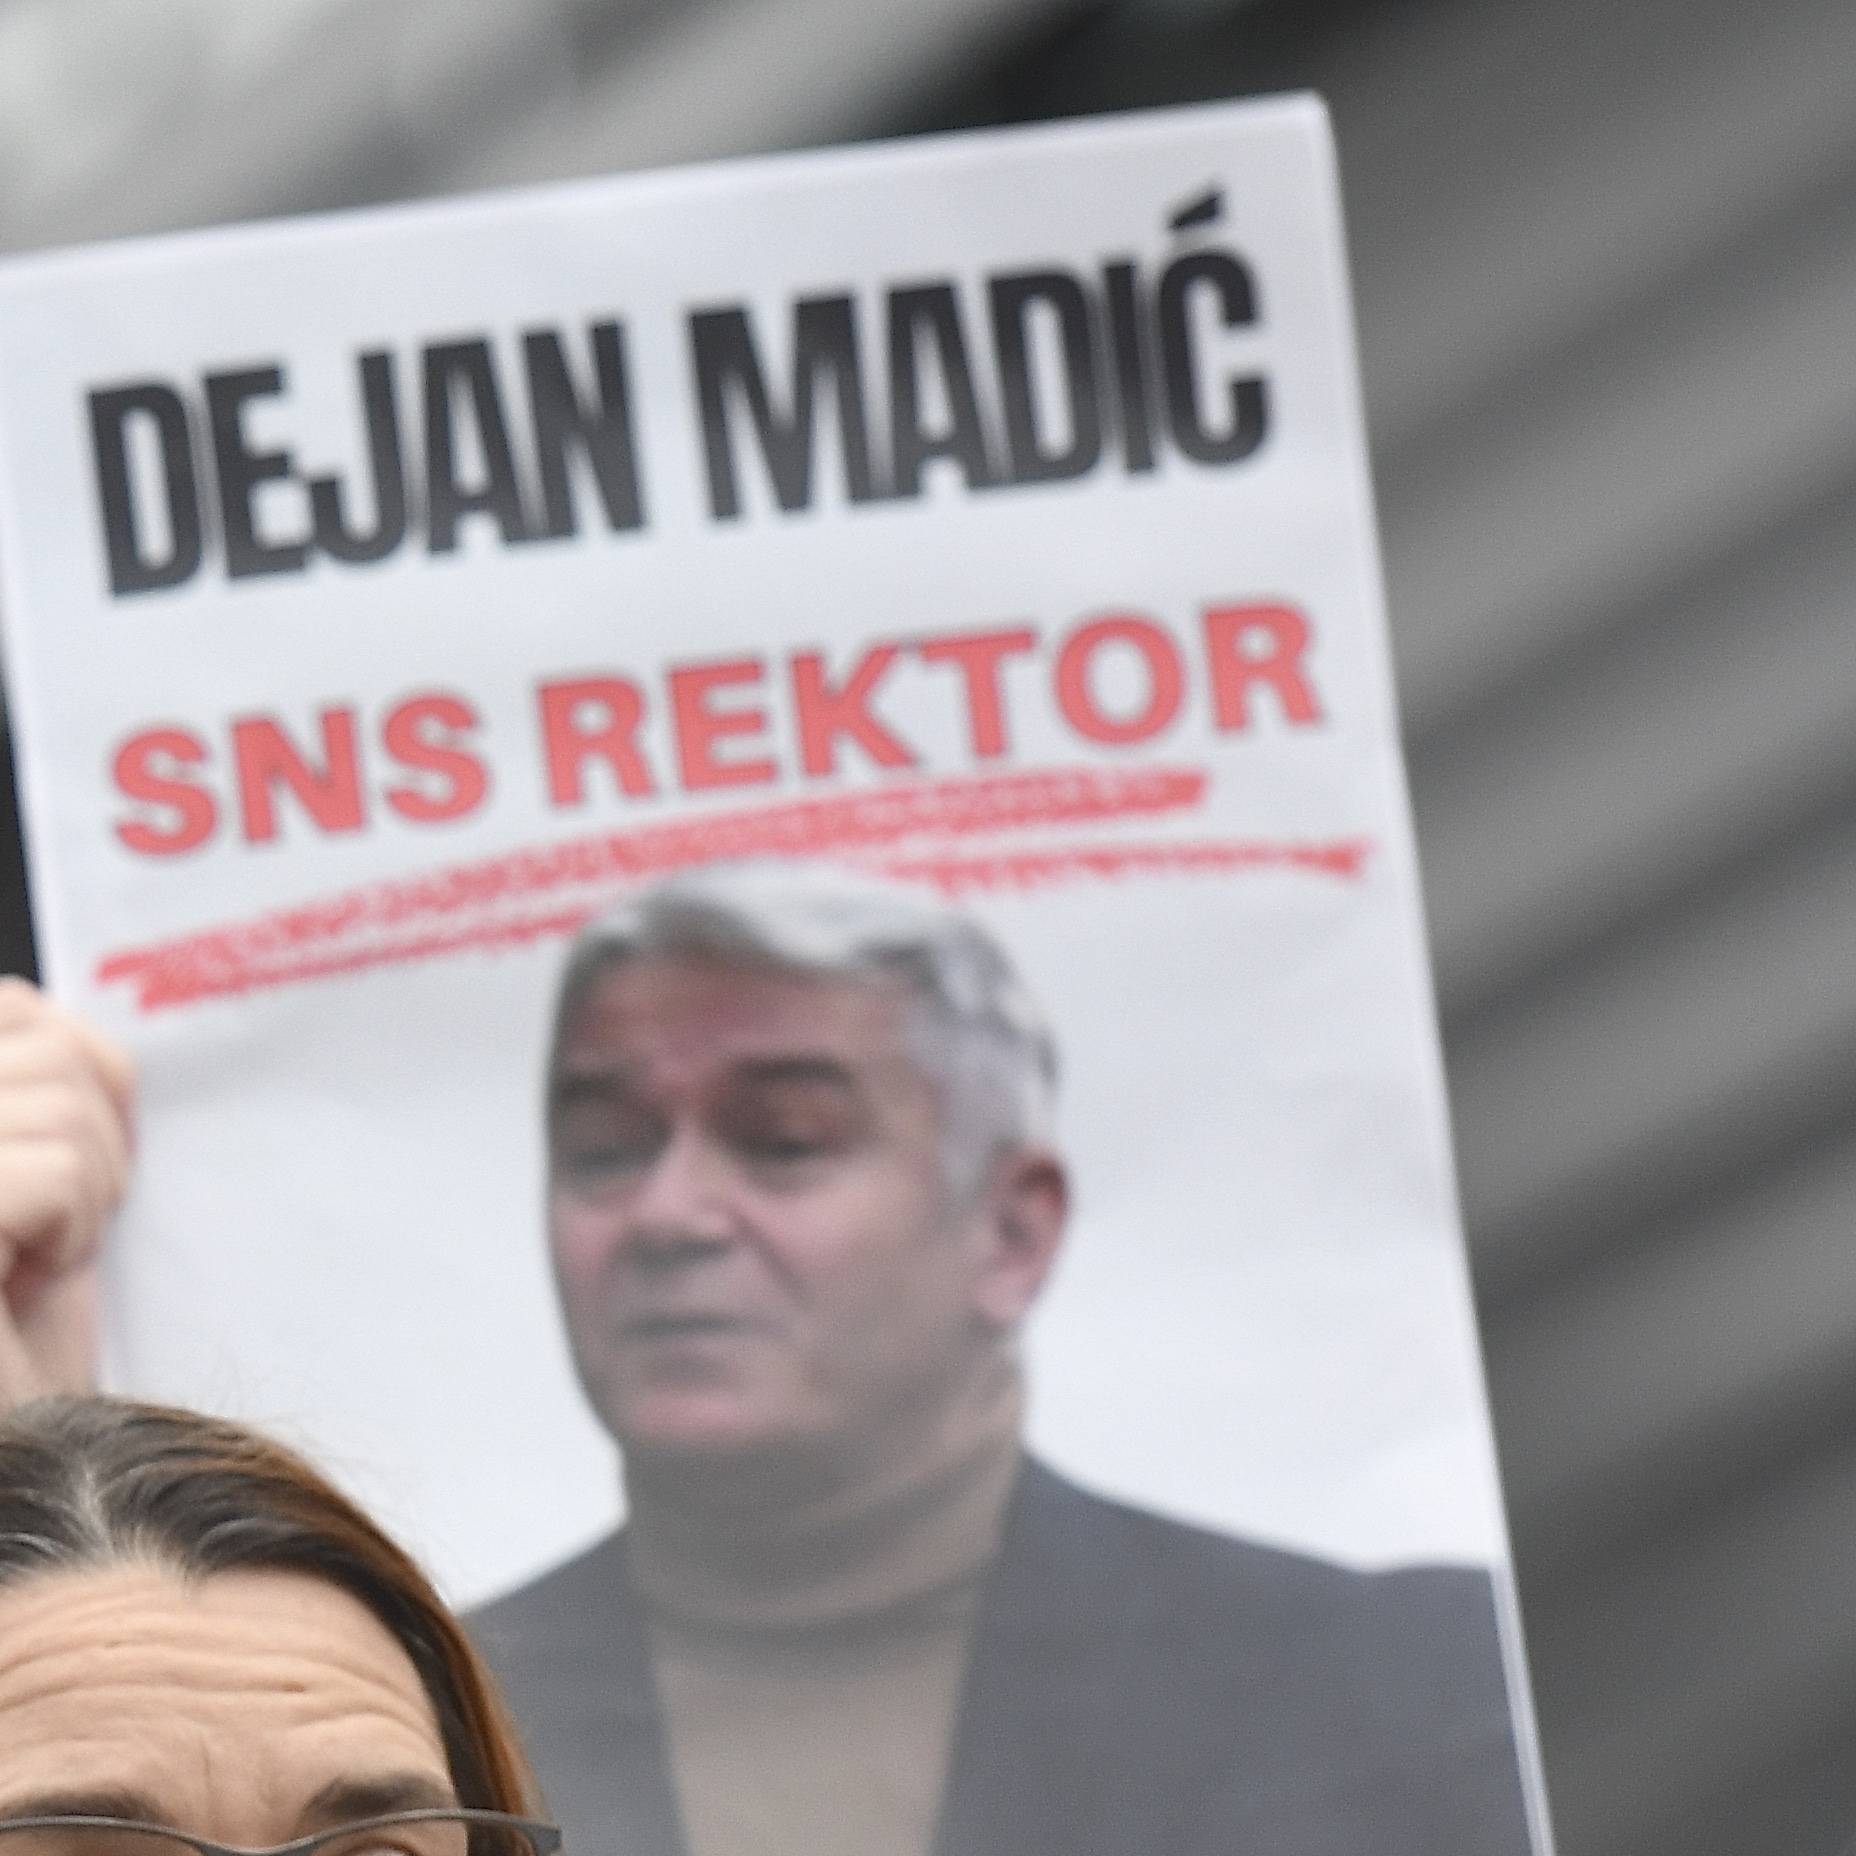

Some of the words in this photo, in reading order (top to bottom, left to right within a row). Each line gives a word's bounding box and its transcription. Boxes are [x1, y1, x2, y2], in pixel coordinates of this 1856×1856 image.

[85, 317, 645, 596] DEJAN
[688, 182, 1272, 519] MADIĆ
[110, 693, 490, 858] SNS
[536, 602, 1322, 808] REKTOR
